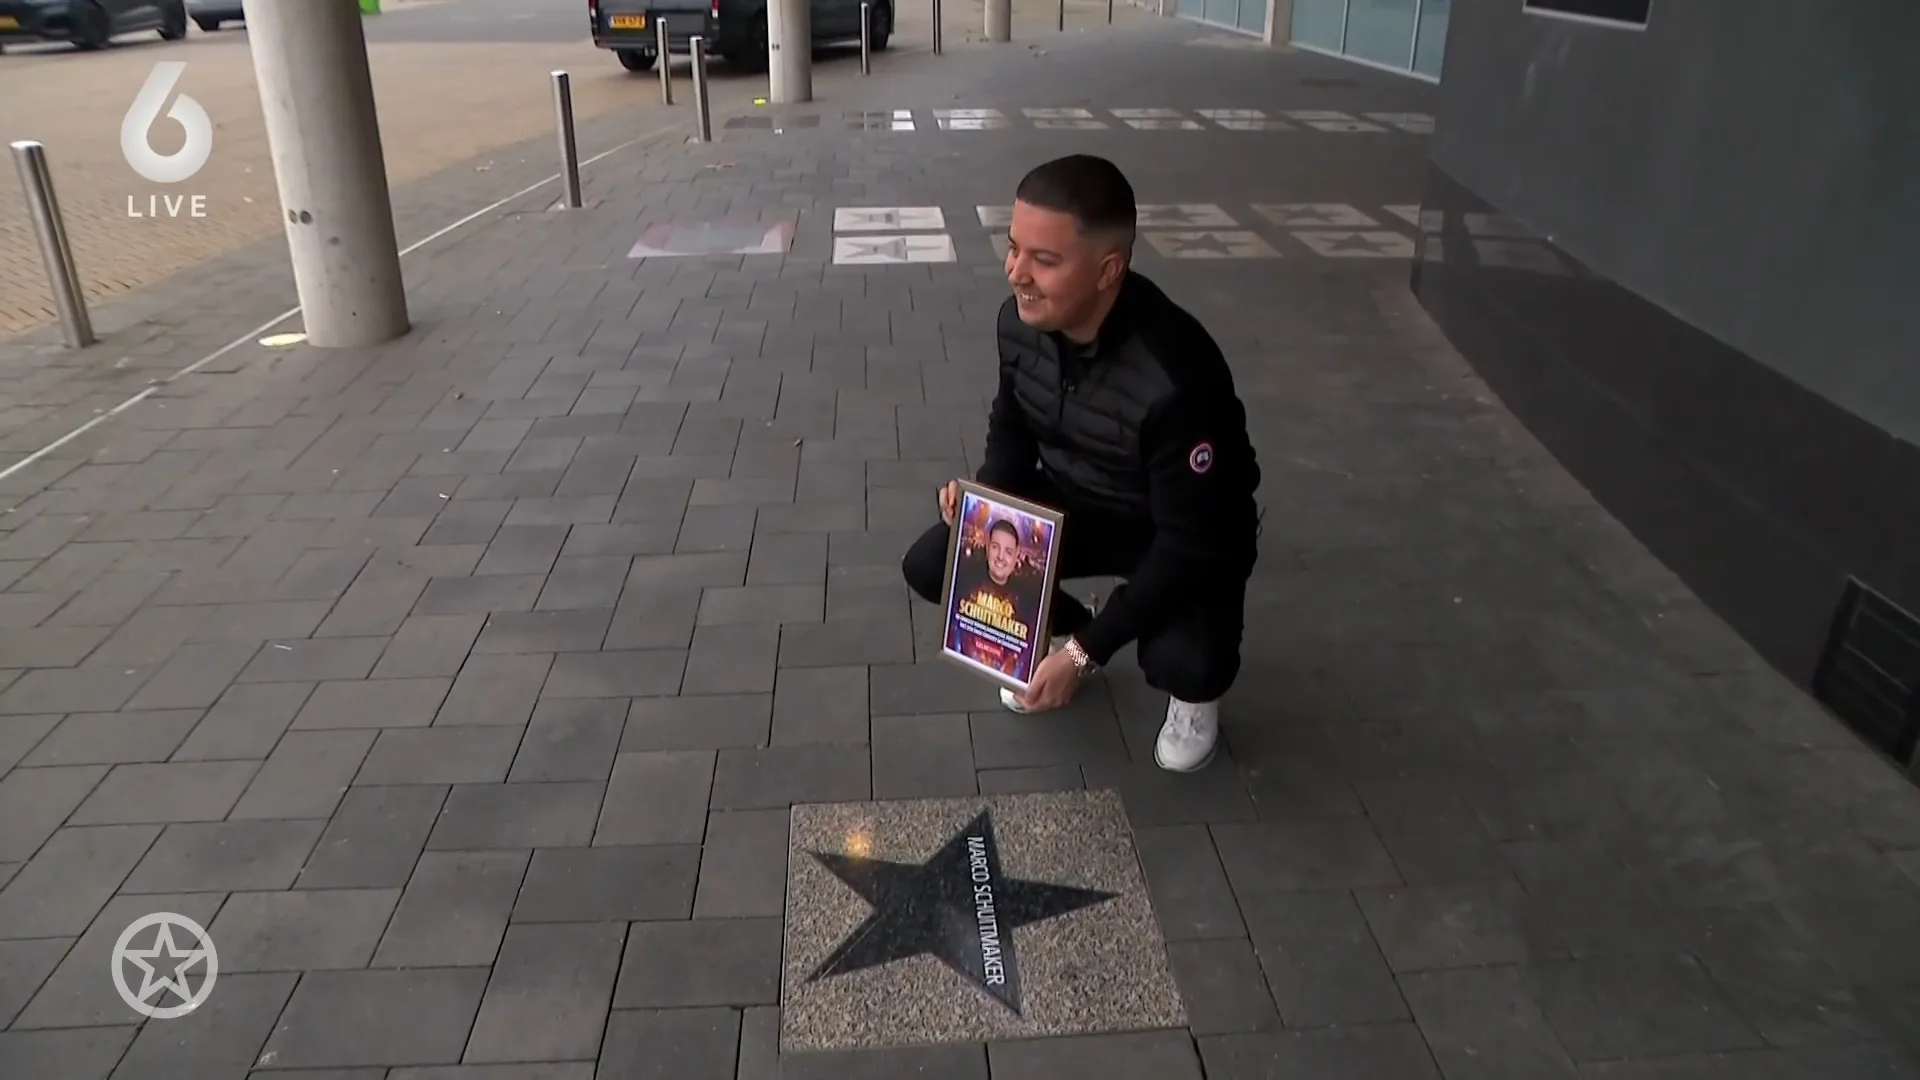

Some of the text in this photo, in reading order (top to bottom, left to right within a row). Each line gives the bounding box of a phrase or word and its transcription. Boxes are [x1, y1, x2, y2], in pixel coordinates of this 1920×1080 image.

[959, 599, 1028, 639] SCHUITMAKER
[976, 591, 1014, 618] MARCO
[967, 836, 1005, 985] MARCO SCHUITMAKER
